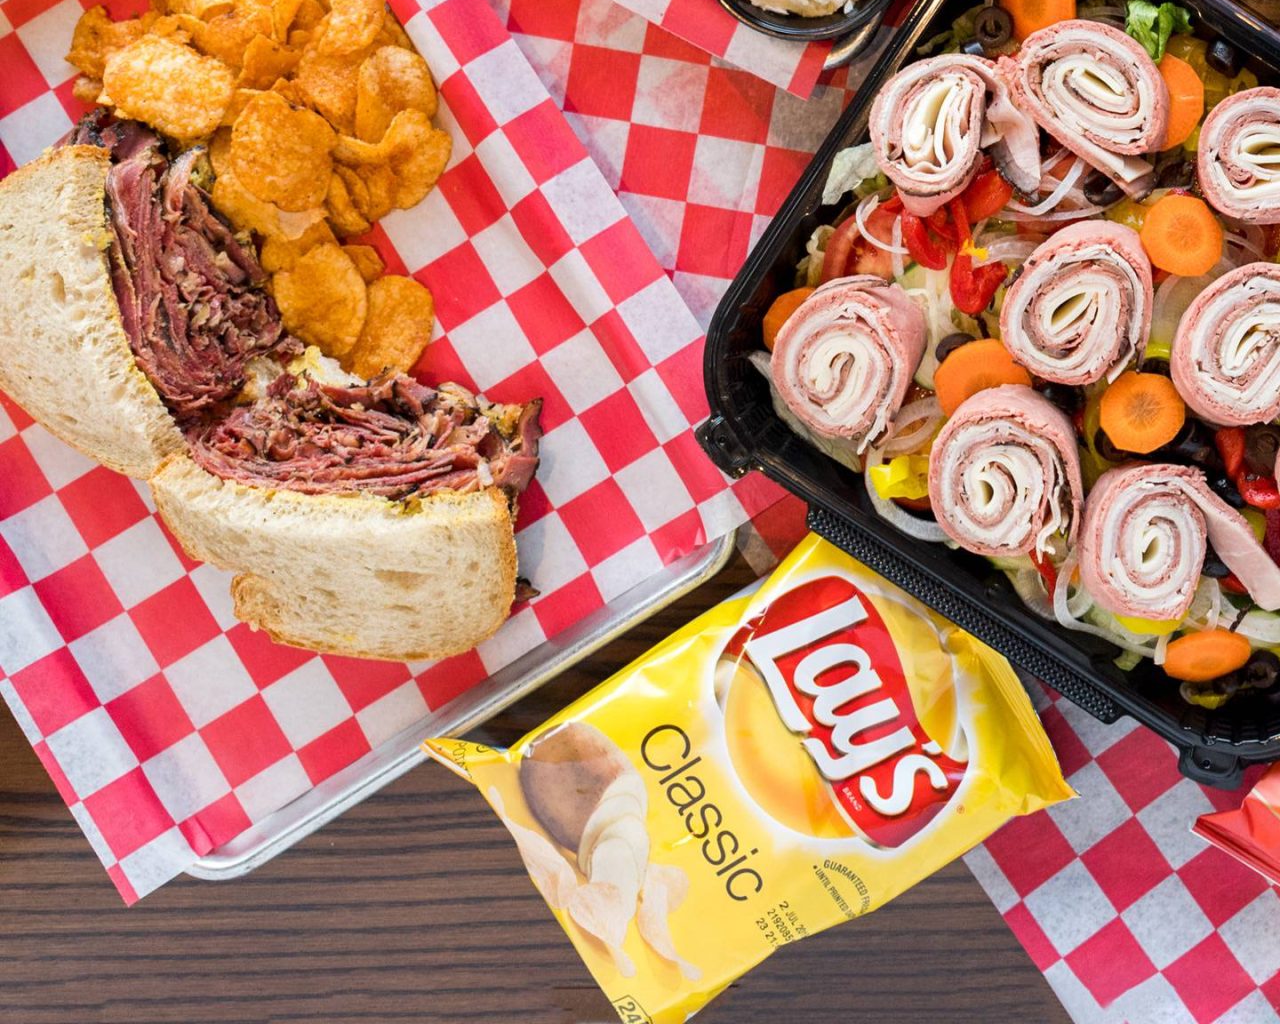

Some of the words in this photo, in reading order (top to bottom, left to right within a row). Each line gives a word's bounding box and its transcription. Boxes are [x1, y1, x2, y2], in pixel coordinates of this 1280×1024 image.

[743, 594, 948, 816] Lay's
[640, 724, 764, 902] Classic
[815, 868, 831, 889] UNTIL
[827, 886, 849, 913] PRINTED
[823, 859, 868, 897] GUARANTEED
[756, 917, 769, 931] 23
[779, 900, 789, 911] 2
[785, 911, 799, 926] JUL
